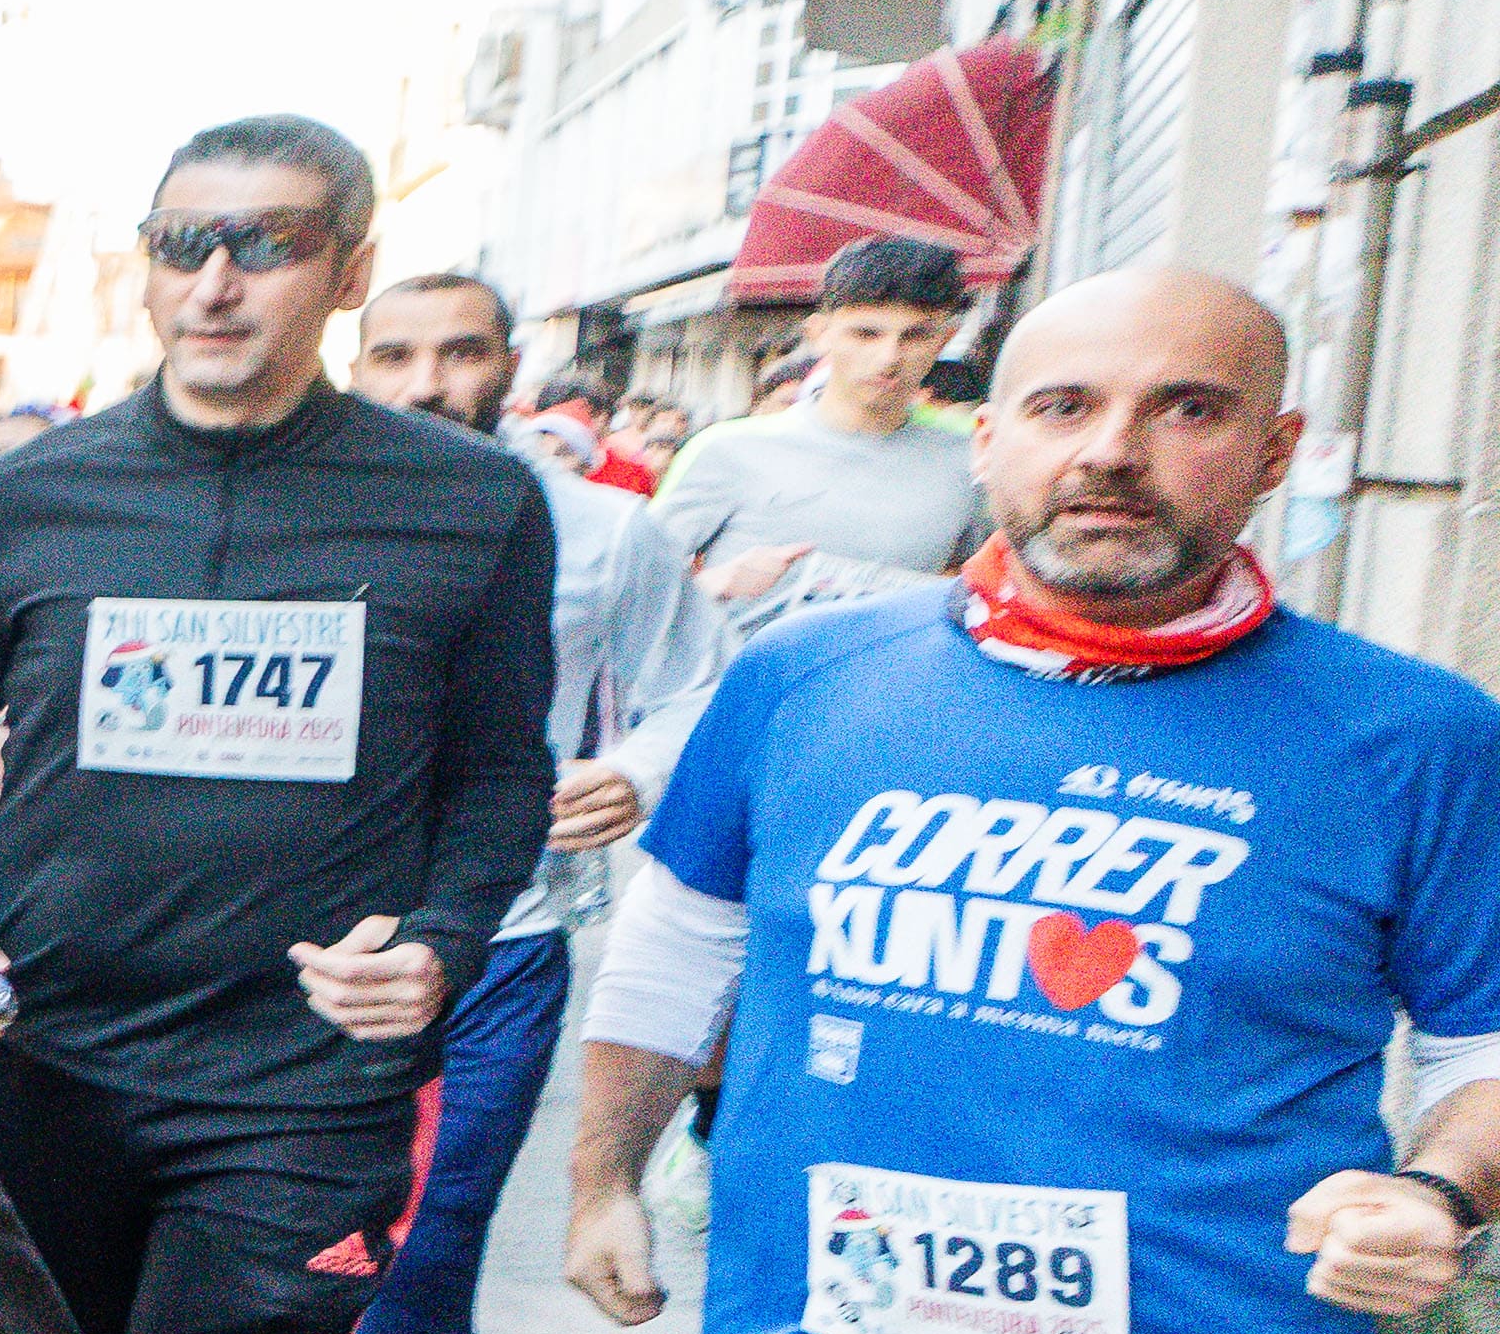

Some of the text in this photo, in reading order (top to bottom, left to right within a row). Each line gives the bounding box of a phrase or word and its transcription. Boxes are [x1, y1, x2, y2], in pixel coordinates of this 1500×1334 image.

[157, 609, 206, 643] SAN
[218, 610, 348, 646] SILVESTRE
[194, 652, 337, 709] 1747
[816, 789, 1250, 925] CORRER
[913, 1231, 1094, 1309] 1289
